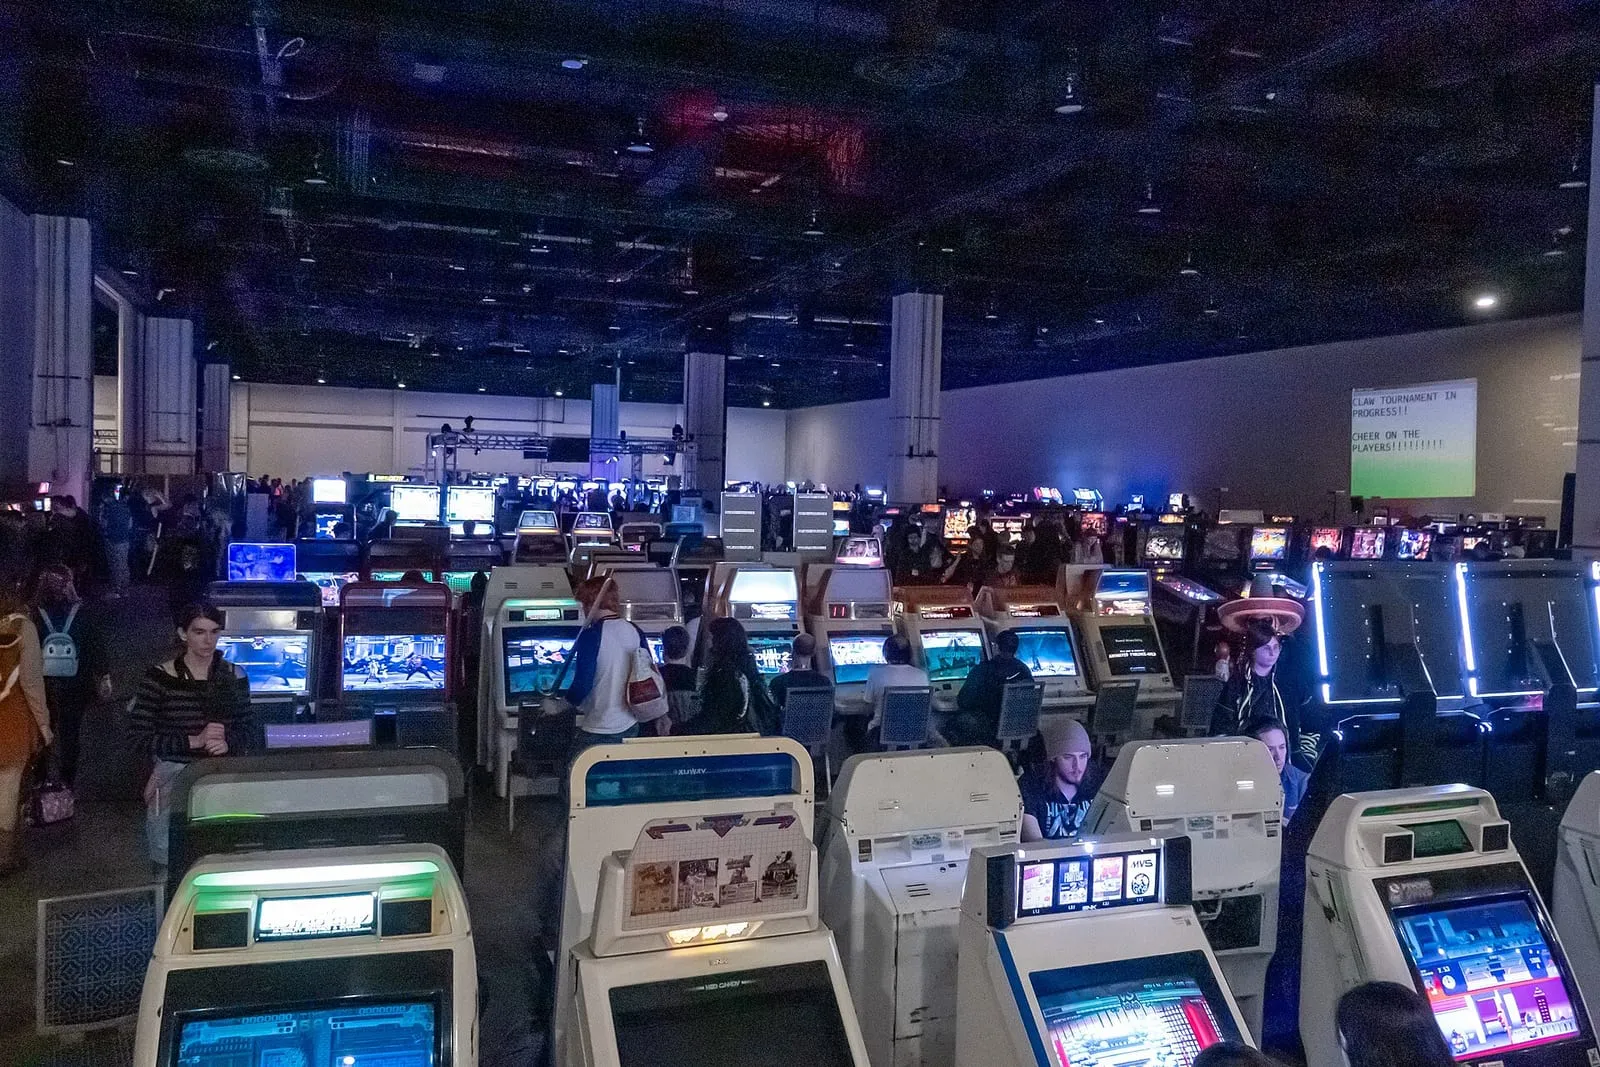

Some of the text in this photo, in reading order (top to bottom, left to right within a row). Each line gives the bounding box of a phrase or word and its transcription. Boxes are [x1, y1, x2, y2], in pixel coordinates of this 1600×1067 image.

[1352, 391, 1457, 406] CLAW TOURNAMENT IN
[1352, 406, 1408, 418] PROGRESS!!
[1352, 429, 1421, 441] CHEER ON THE
[1130, 859, 1154, 869] MVS
